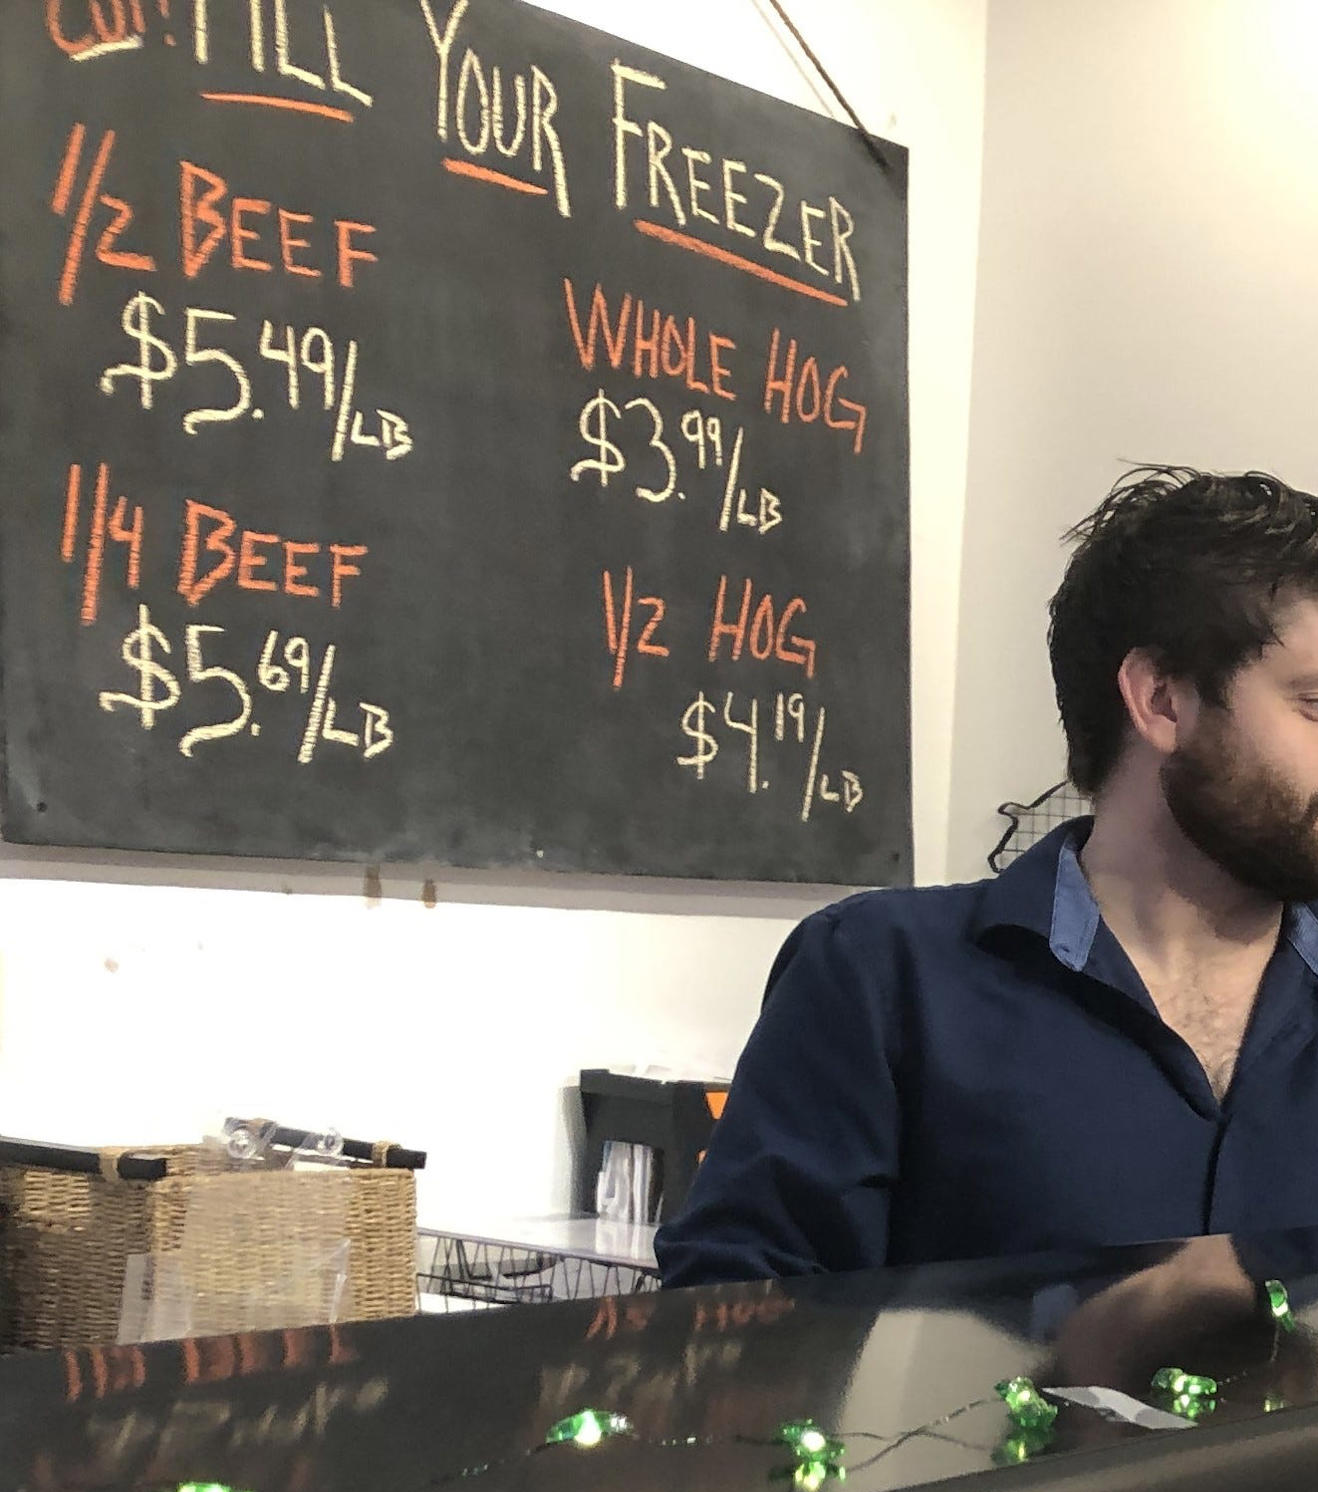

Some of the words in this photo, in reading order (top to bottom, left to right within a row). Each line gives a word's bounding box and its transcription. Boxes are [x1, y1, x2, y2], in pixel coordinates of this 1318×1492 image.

[52, 123, 155, 305] 1/2
[180, 161, 378, 288] BEEF
[421, 0, 571, 217] YOUR
[610, 58, 860, 301] FREEZER
[100, 291, 413, 461] $5.49/LB
[564, 279, 738, 400] WHOLE
[765, 330, 867, 453] HOG
[571, 390, 783, 532] $3.99/LB
[61, 464, 143, 626] 1/4
[178, 500, 368, 607] BEEF
[99, 604, 393, 763] $5.69/LB
[603, 568, 670, 690] 1/2
[710, 577, 816, 678] HOG
[676, 692, 864, 821] $4.19/LB
